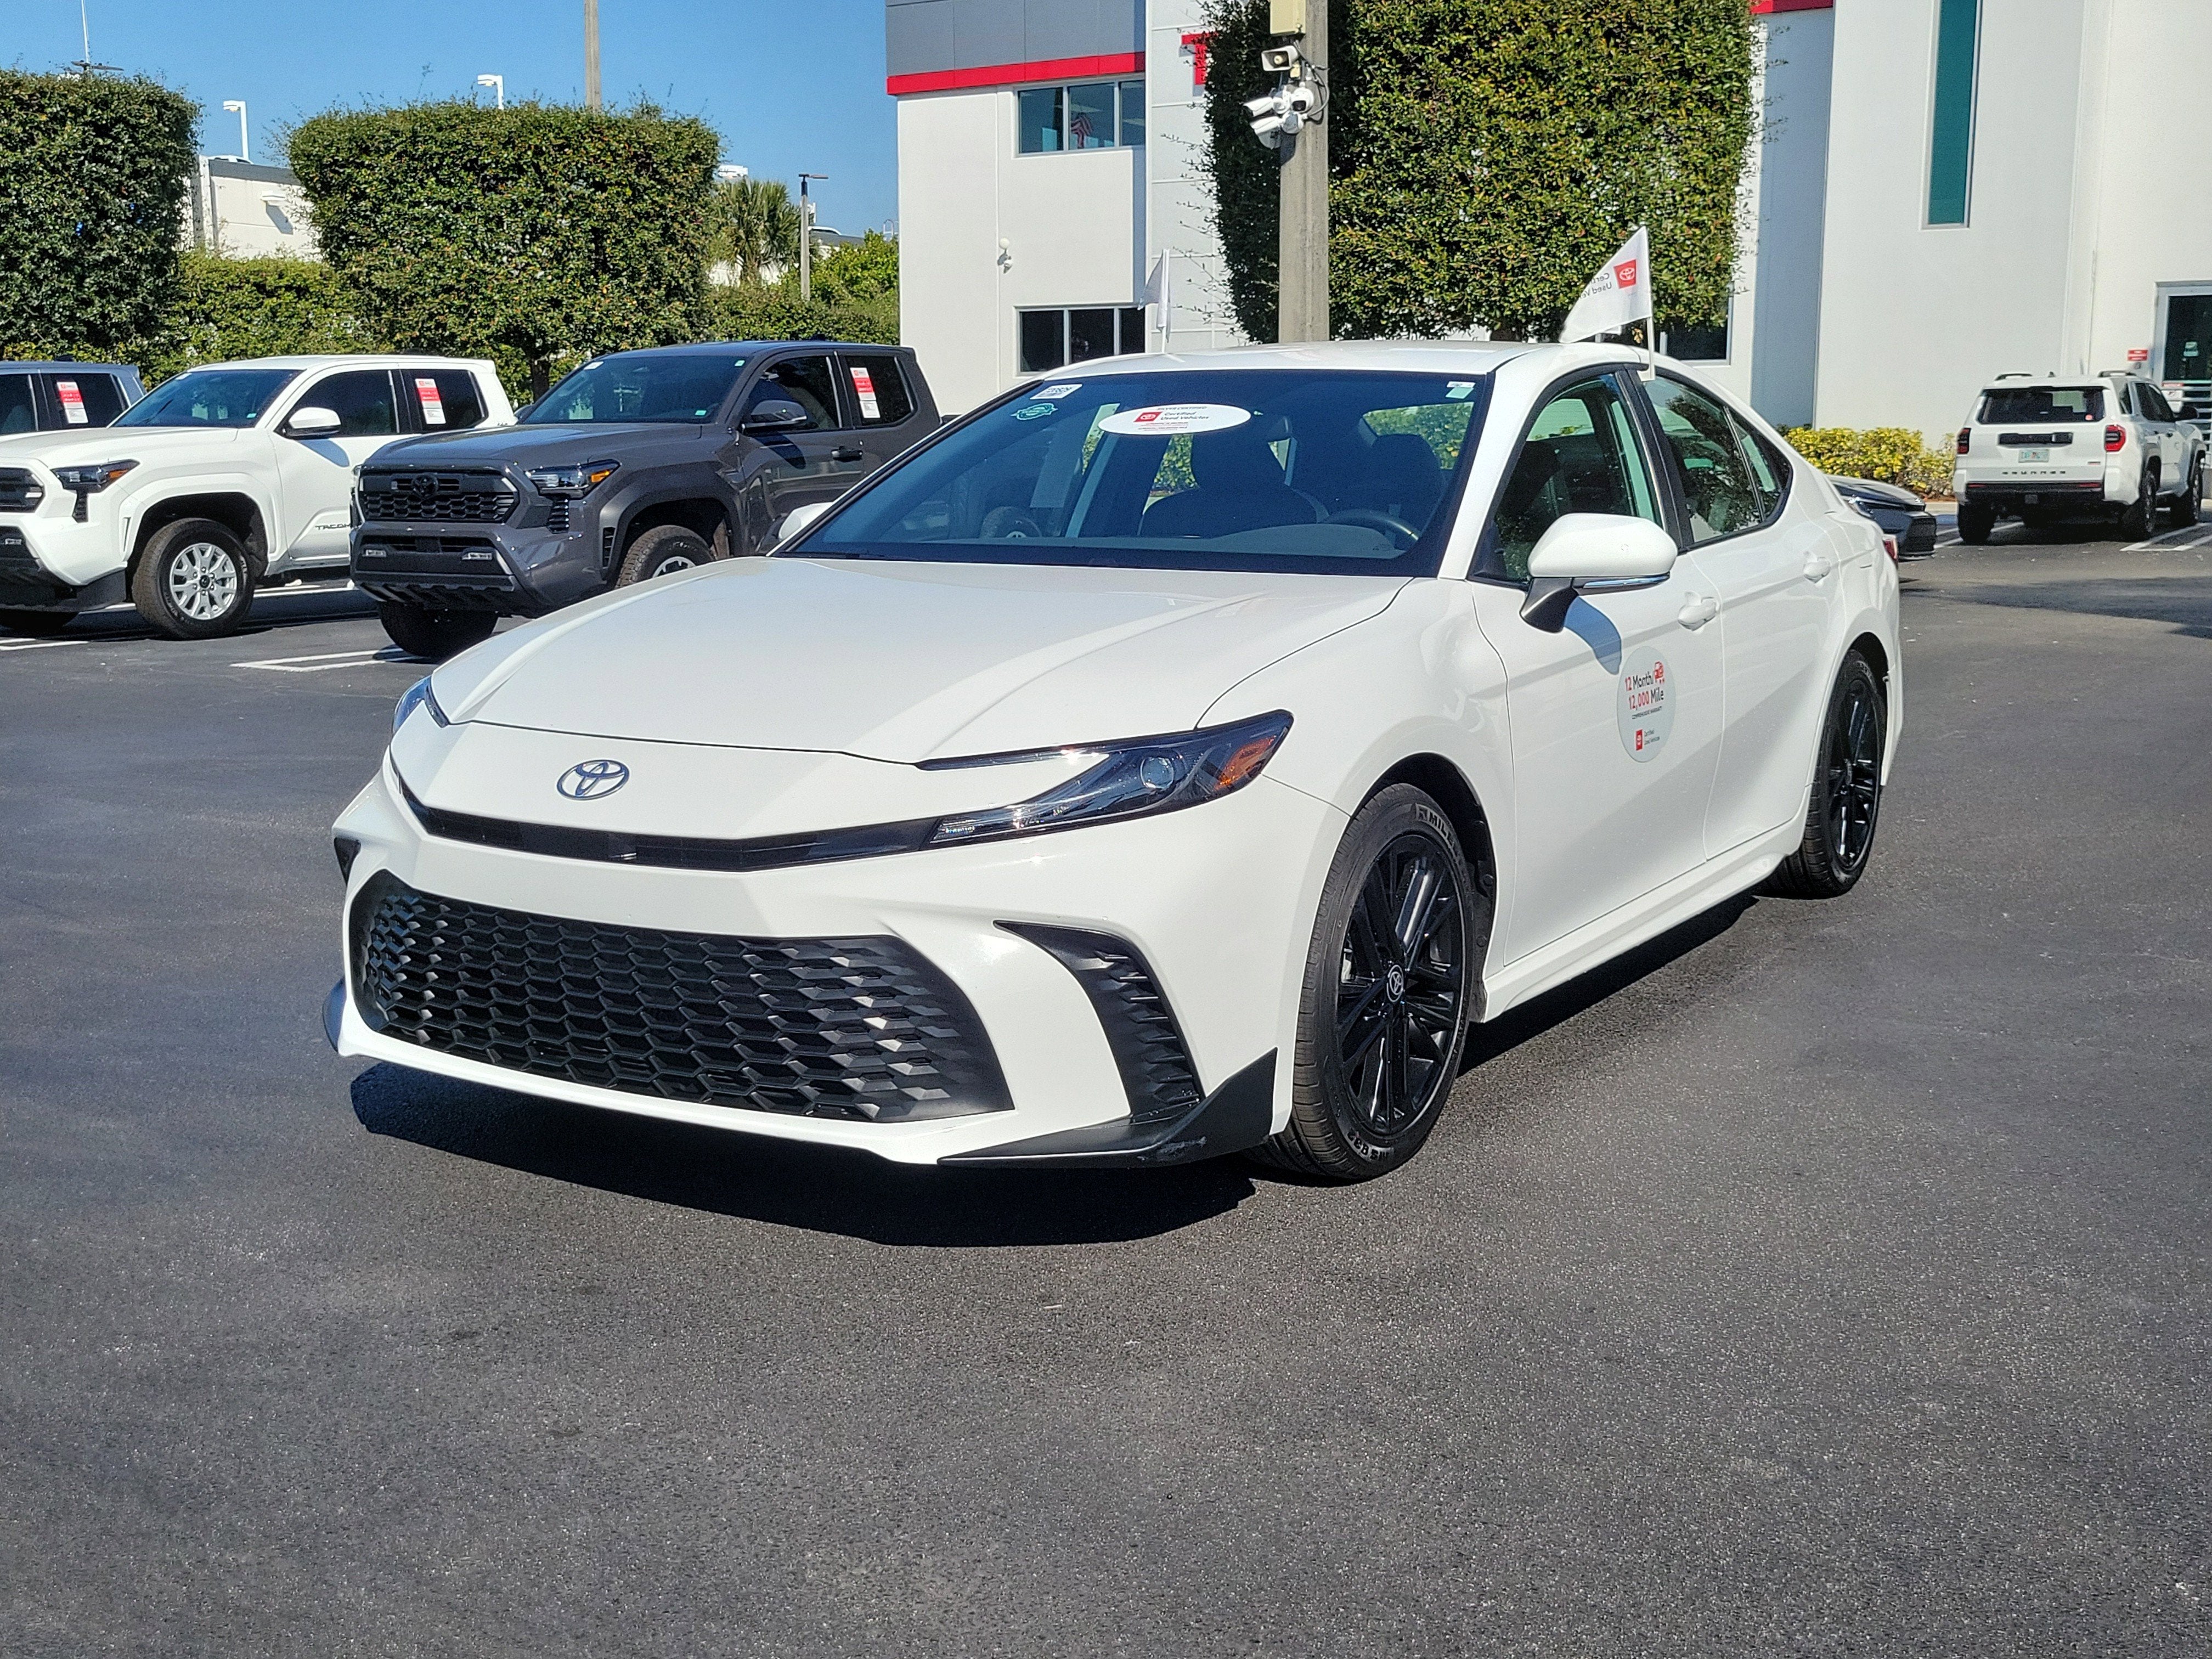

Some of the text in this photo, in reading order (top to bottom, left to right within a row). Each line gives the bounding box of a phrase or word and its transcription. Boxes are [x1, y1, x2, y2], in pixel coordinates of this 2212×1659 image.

[1625, 677, 1632, 691] 12
[1629, 687, 1664, 710] 12,000 Mile
